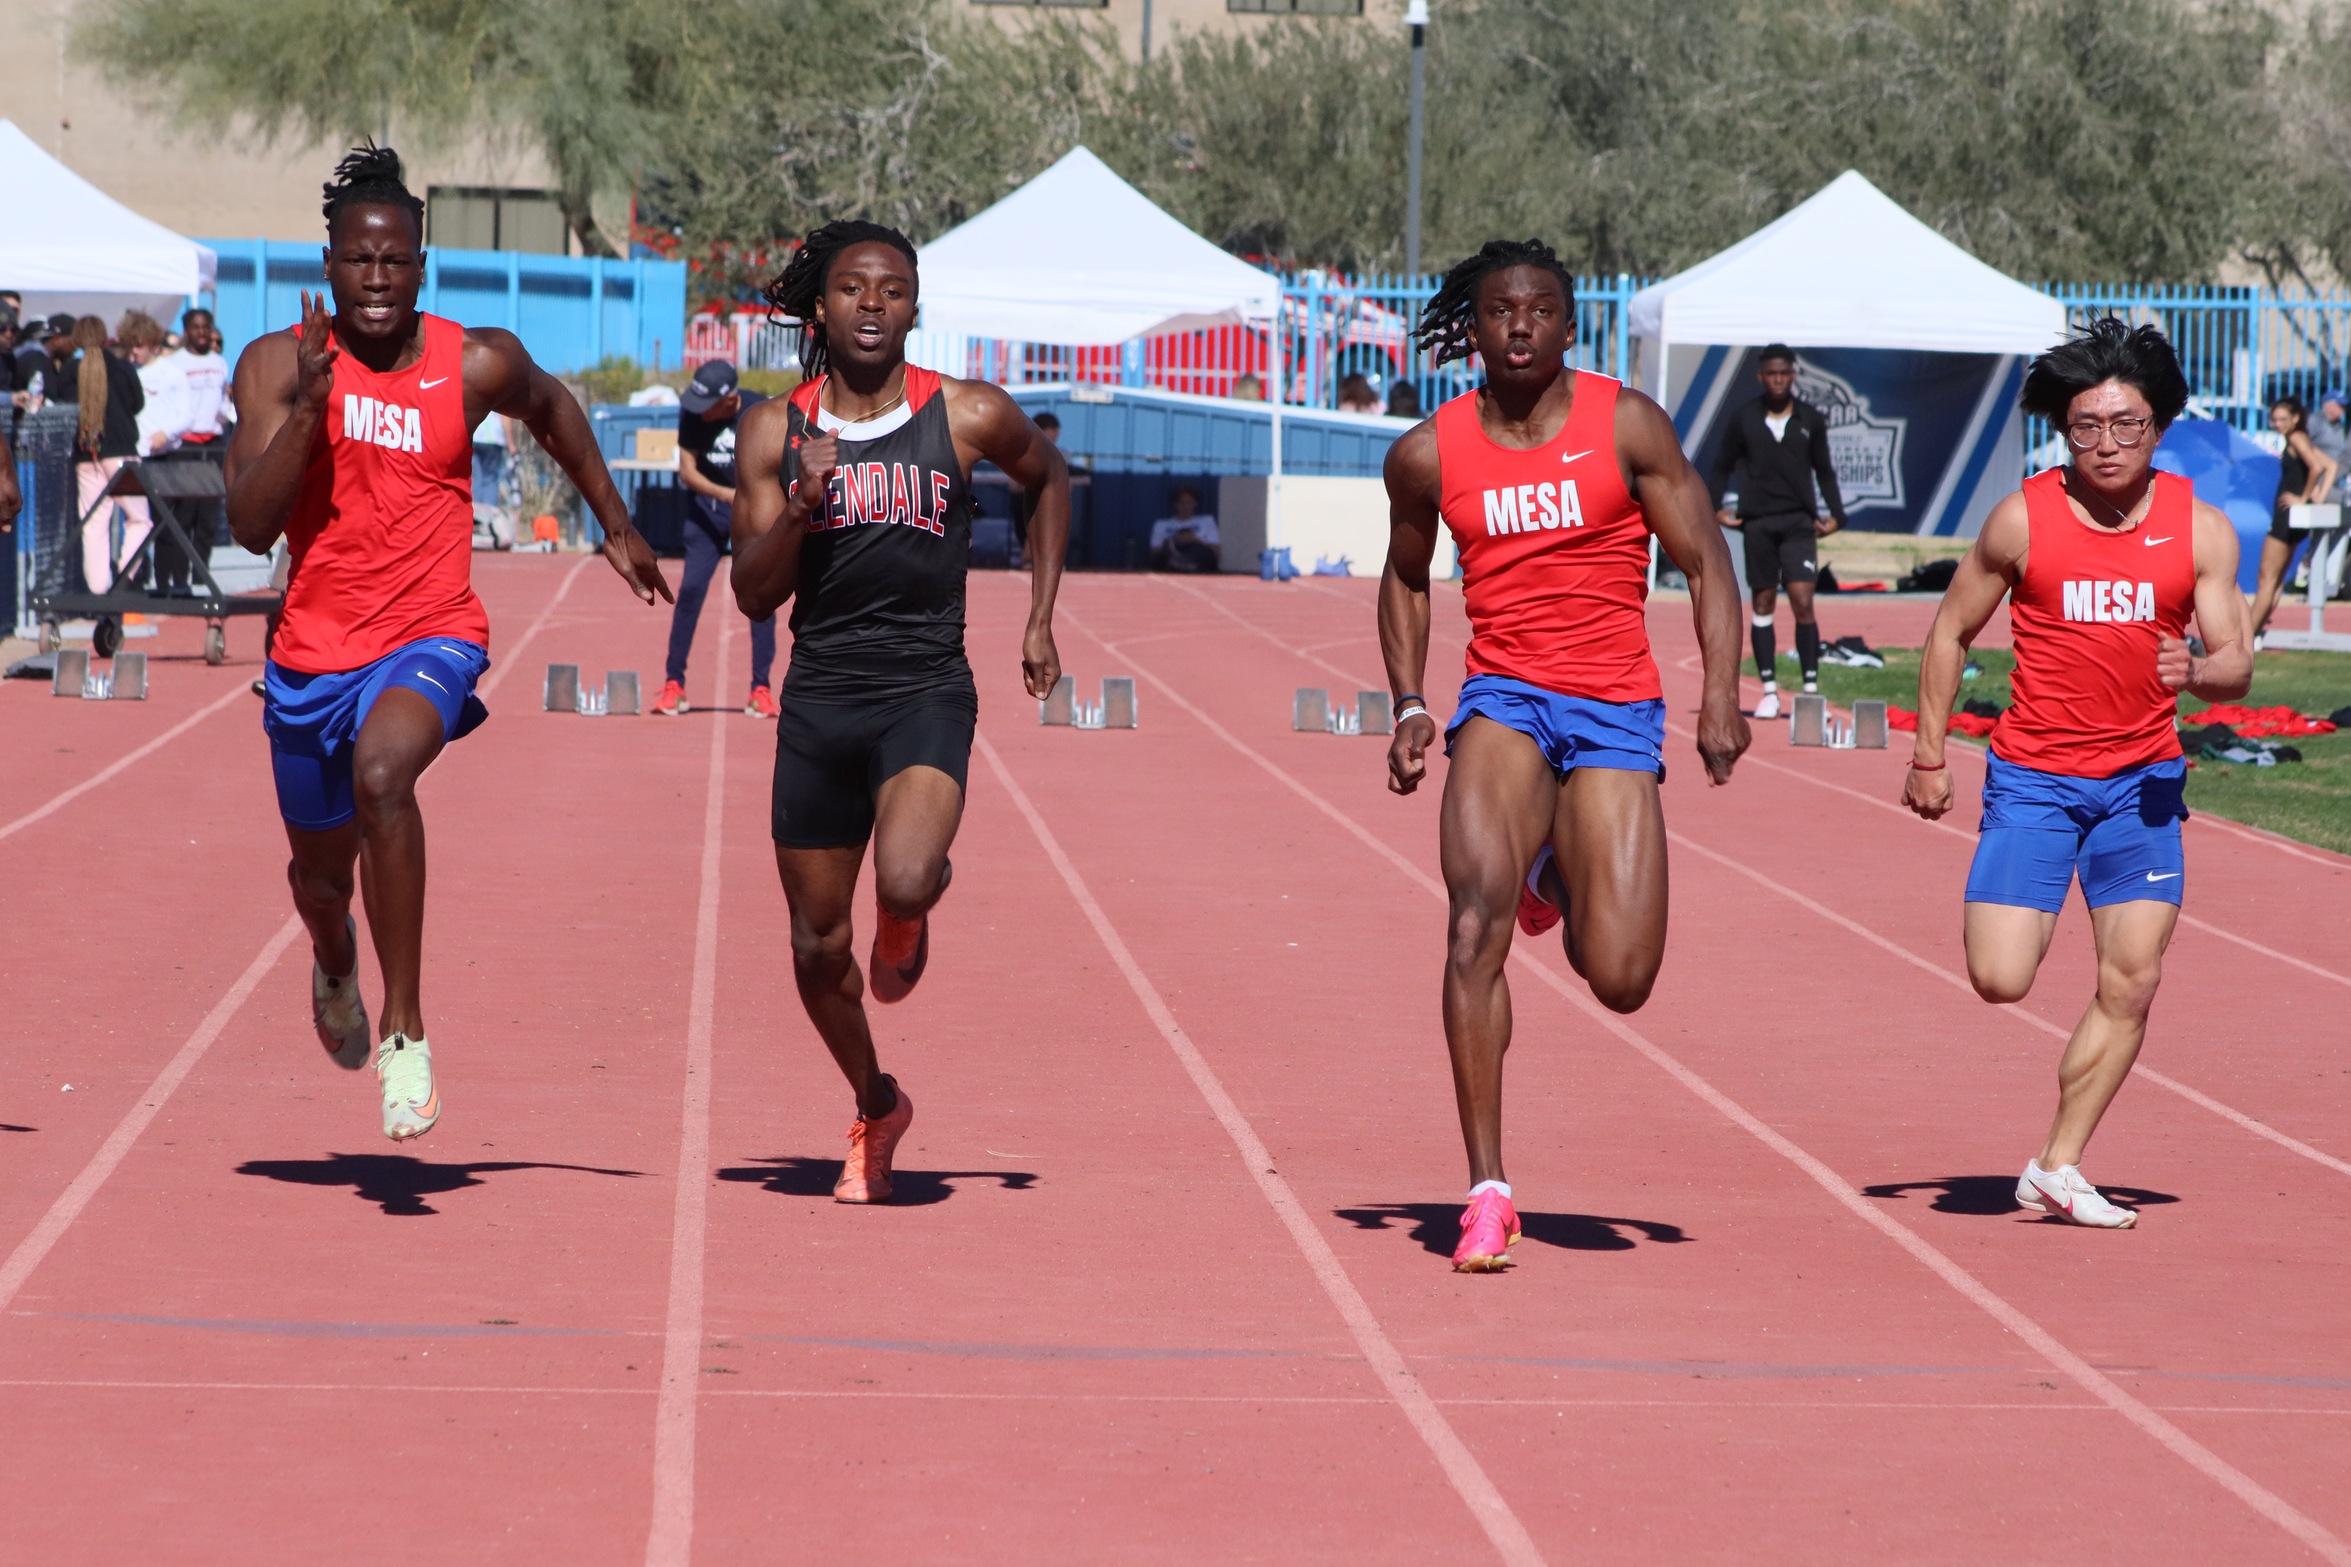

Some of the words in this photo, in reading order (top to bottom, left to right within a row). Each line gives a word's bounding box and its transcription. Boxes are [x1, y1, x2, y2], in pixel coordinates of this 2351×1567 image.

[344, 393, 422, 453] MESA
[1483, 479, 1584, 536] MESA
[2062, 580, 2155, 622] MESA
